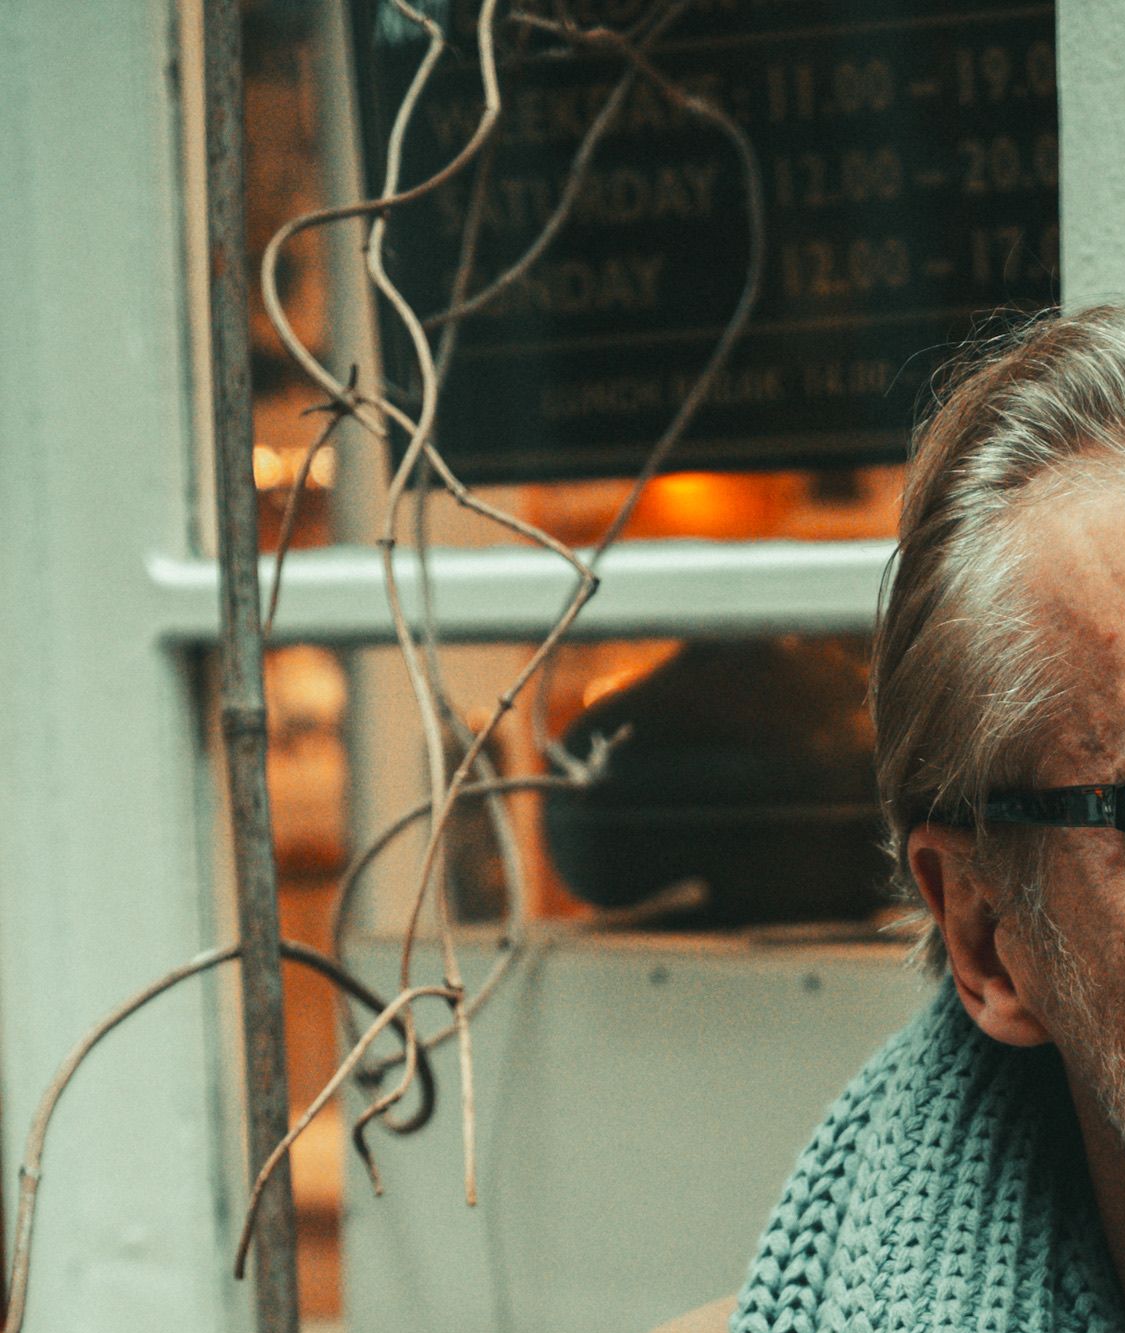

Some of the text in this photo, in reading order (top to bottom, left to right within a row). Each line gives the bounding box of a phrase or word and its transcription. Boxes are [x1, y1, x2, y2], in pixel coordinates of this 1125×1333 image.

[766, 57, 895, 122] 11.00
[775, 145, 904, 208] 12.00
[783, 237, 910, 297] 12.00
